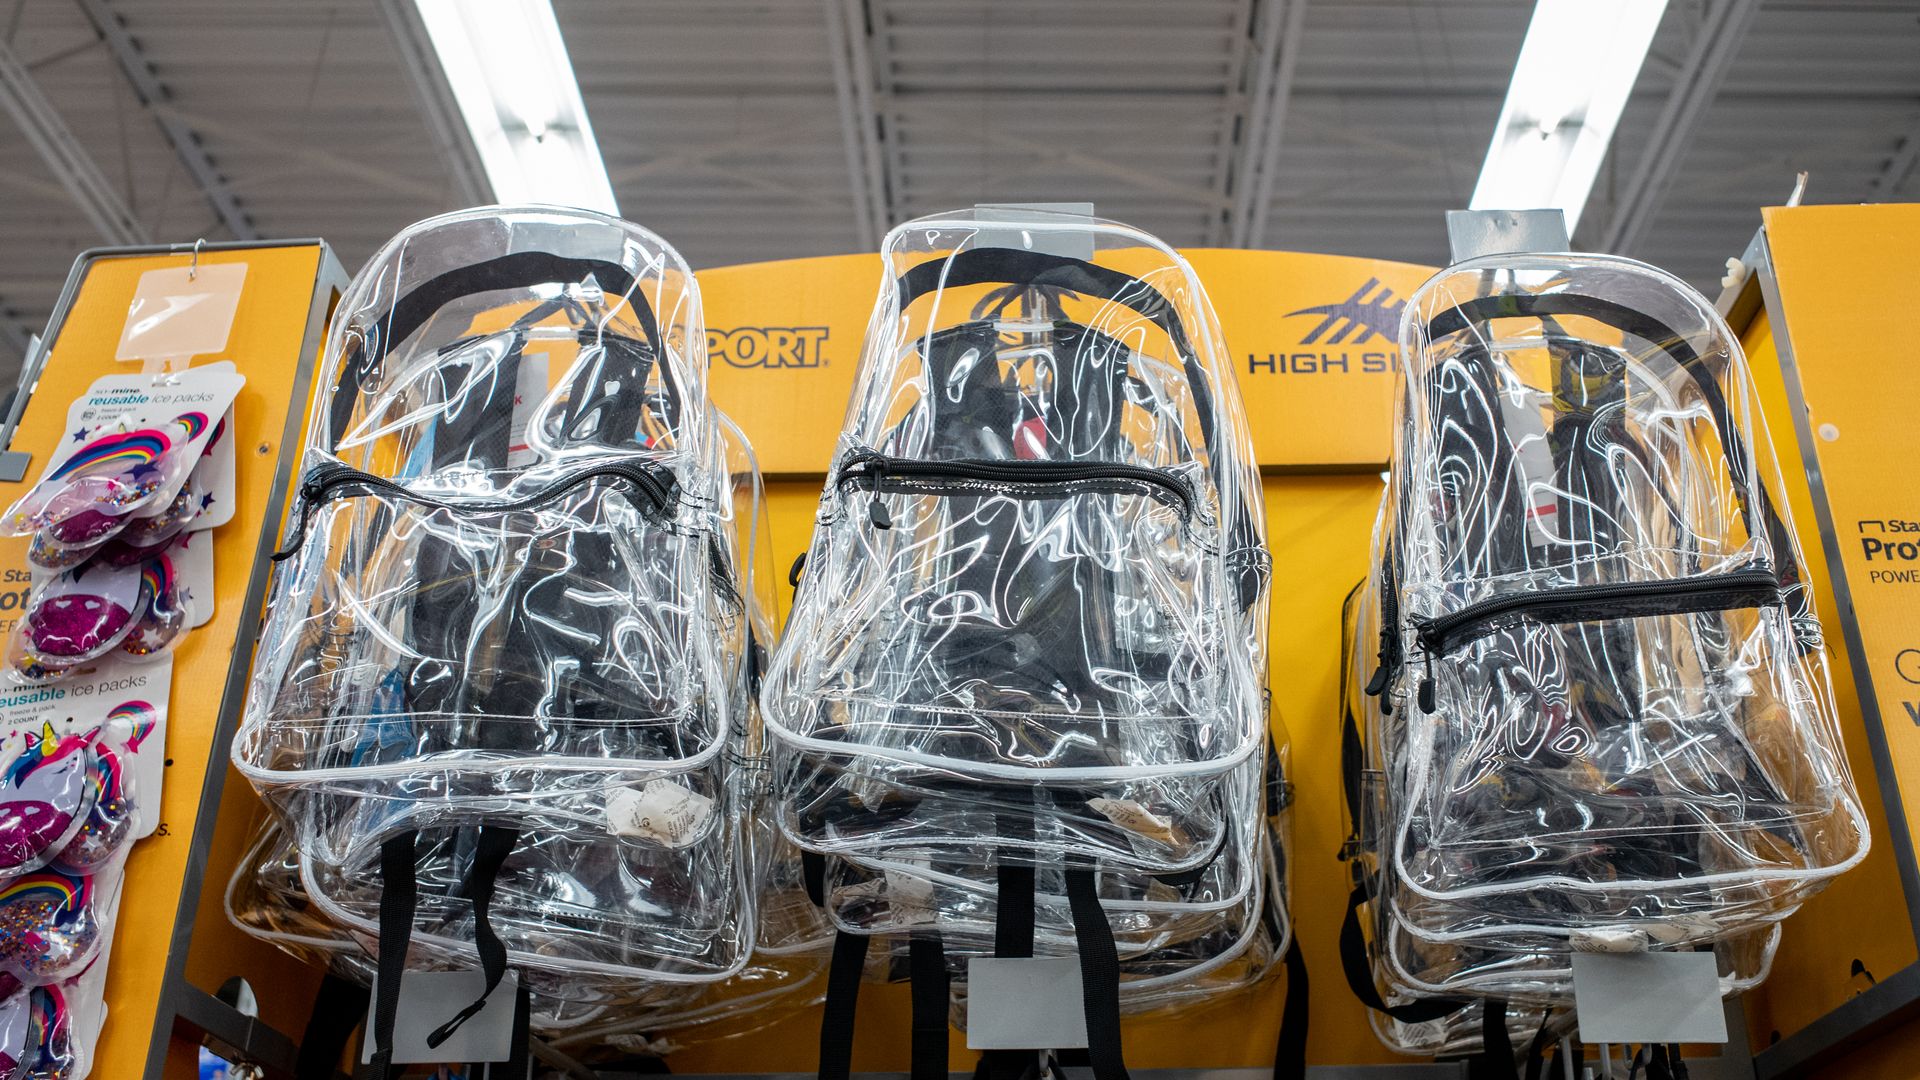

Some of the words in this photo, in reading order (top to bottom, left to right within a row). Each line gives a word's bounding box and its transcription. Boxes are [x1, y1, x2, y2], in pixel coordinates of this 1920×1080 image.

[1248, 352, 1349, 374] HIGH
[88, 394, 150, 406] reusable
[151, 393, 172, 404] ice
[172, 391, 215, 405] packs
[1888, 519, 1920, 533] Sta
[1861, 537, 1920, 561] Pro
[1870, 569, 1920, 584] POWE
[0, 687, 66, 708] eusable
[70, 684, 95, 697] ice
[98, 675, 148, 696] packs
